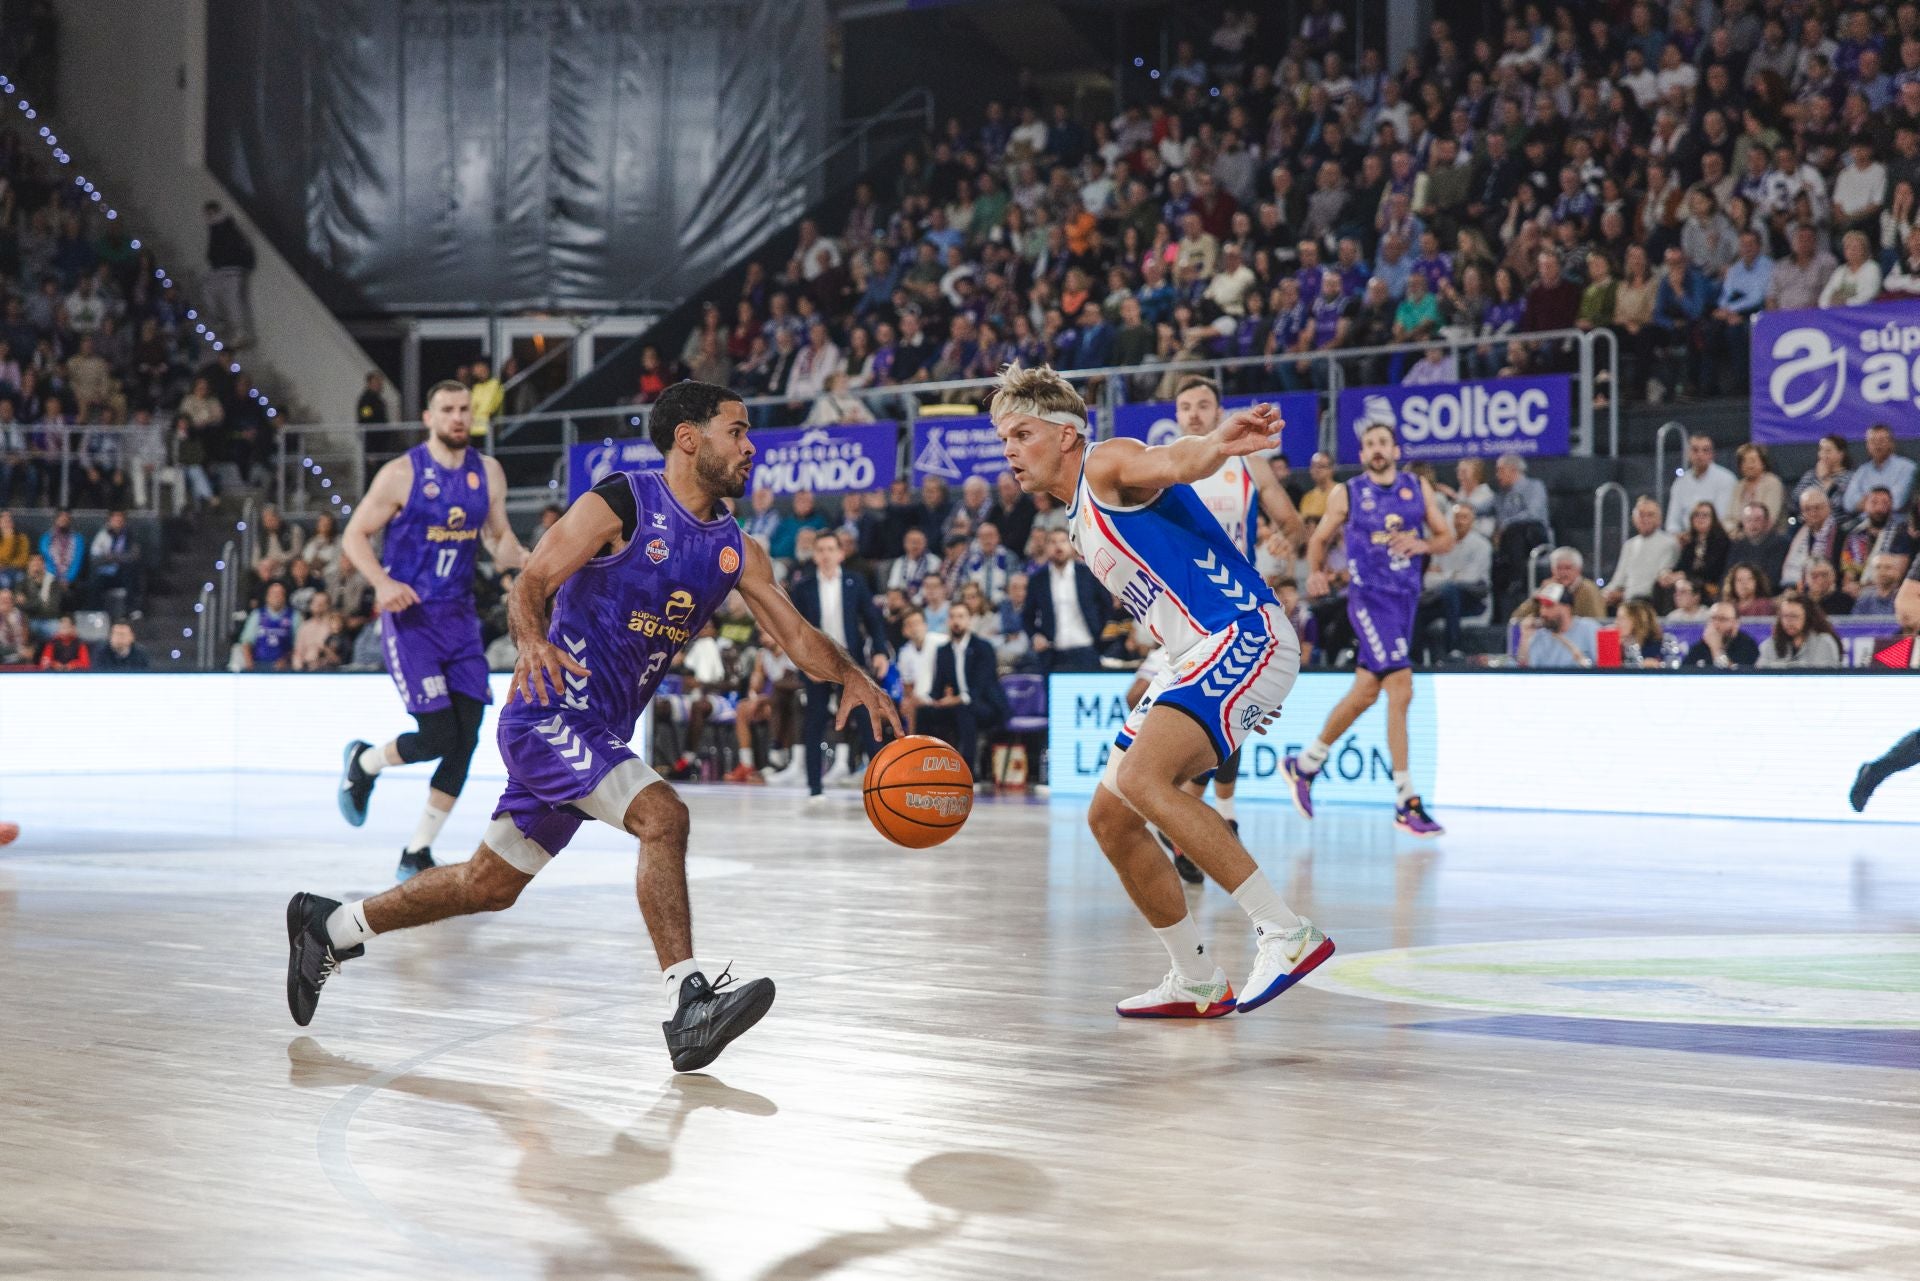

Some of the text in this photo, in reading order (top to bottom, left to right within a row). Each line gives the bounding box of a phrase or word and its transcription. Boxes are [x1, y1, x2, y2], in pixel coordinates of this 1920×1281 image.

[1861, 352, 1920, 409] a
[1401, 384, 1549, 442] soltec
[752, 457, 875, 493] MUNDO
[436, 548, 458, 578] 17
[631, 610, 662, 622] súper
[905, 791, 970, 817] Wilson
